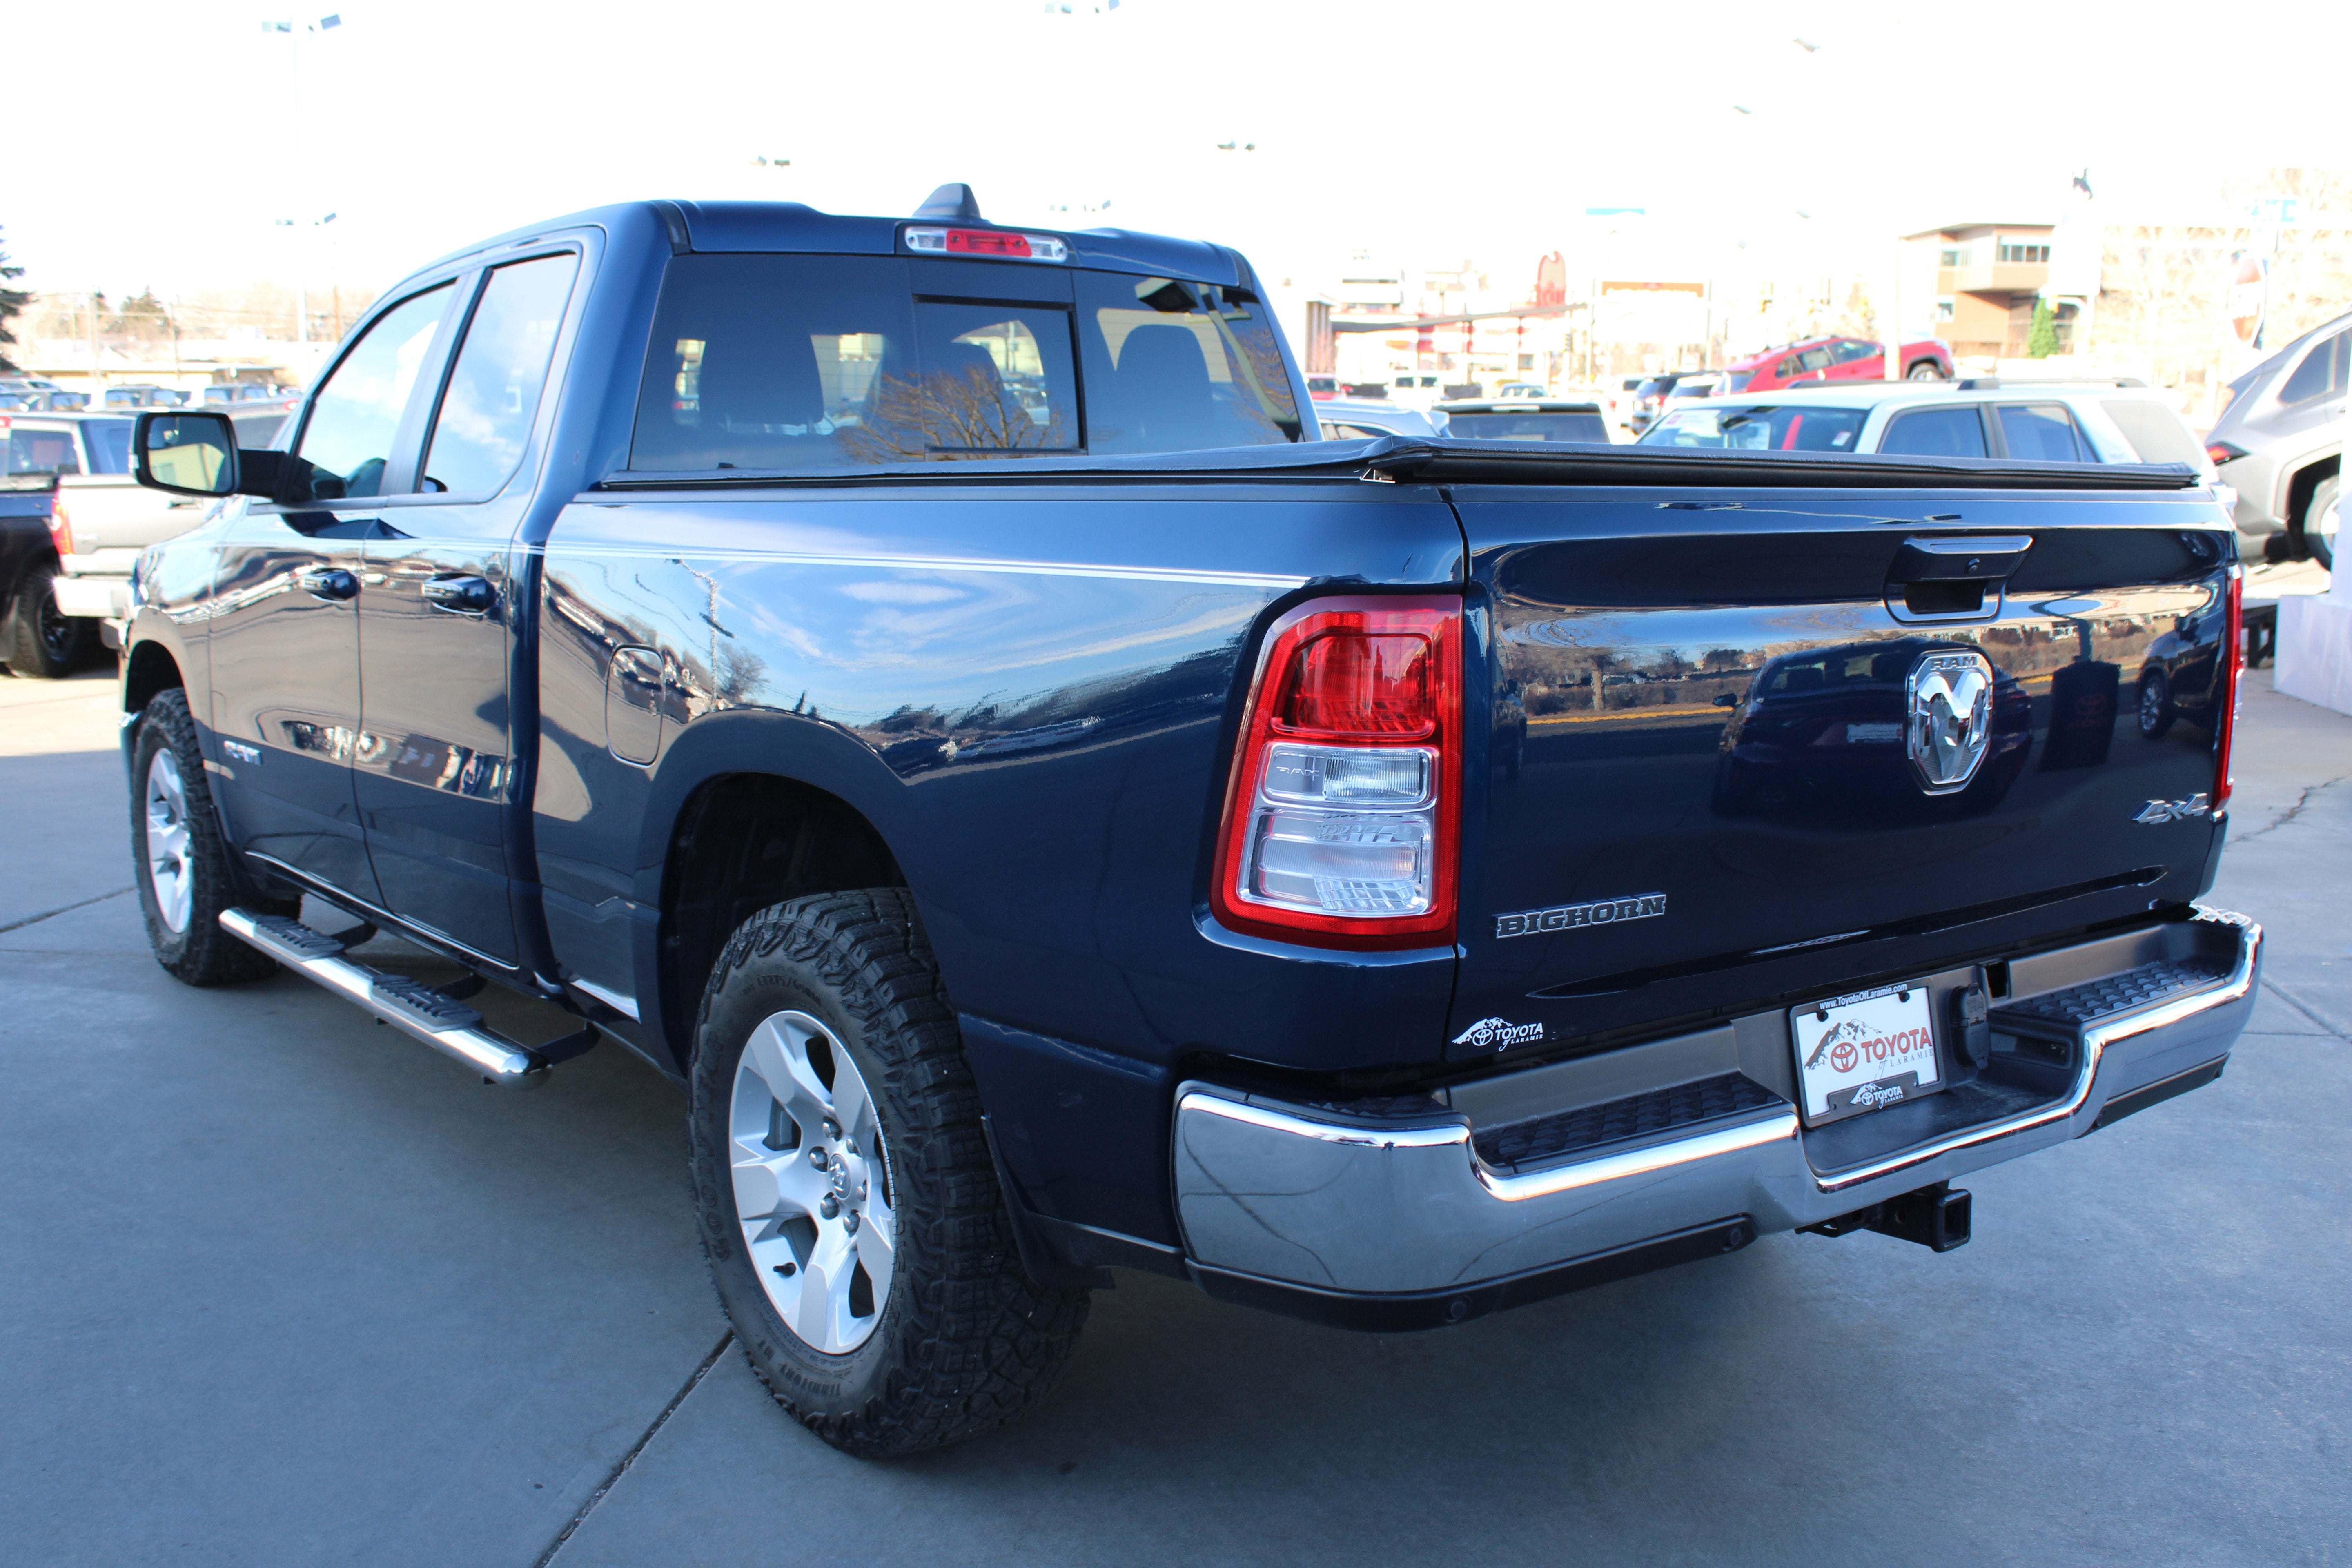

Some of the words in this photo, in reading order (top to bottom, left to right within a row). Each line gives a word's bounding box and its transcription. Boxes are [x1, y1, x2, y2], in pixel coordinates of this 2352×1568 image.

[1930, 656, 1977, 670] RAM
[1276, 766, 1320, 777] RAM
[1493, 893, 1667, 939] BIGHORN
[1820, 983, 1907, 1010] www.ToyotaOfLaramie.com
[1495, 1022, 1543, 1041] TOYOTA
[1511, 1034, 1543, 1044] LARAMIE
[1860, 1027, 1932, 1063] TOYOTA
[1890, 1048, 1934, 1067] LARAMIE
[1873, 1085, 1903, 1101] TOYOTA
[1884, 1094, 1904, 1103] LARAMIE
